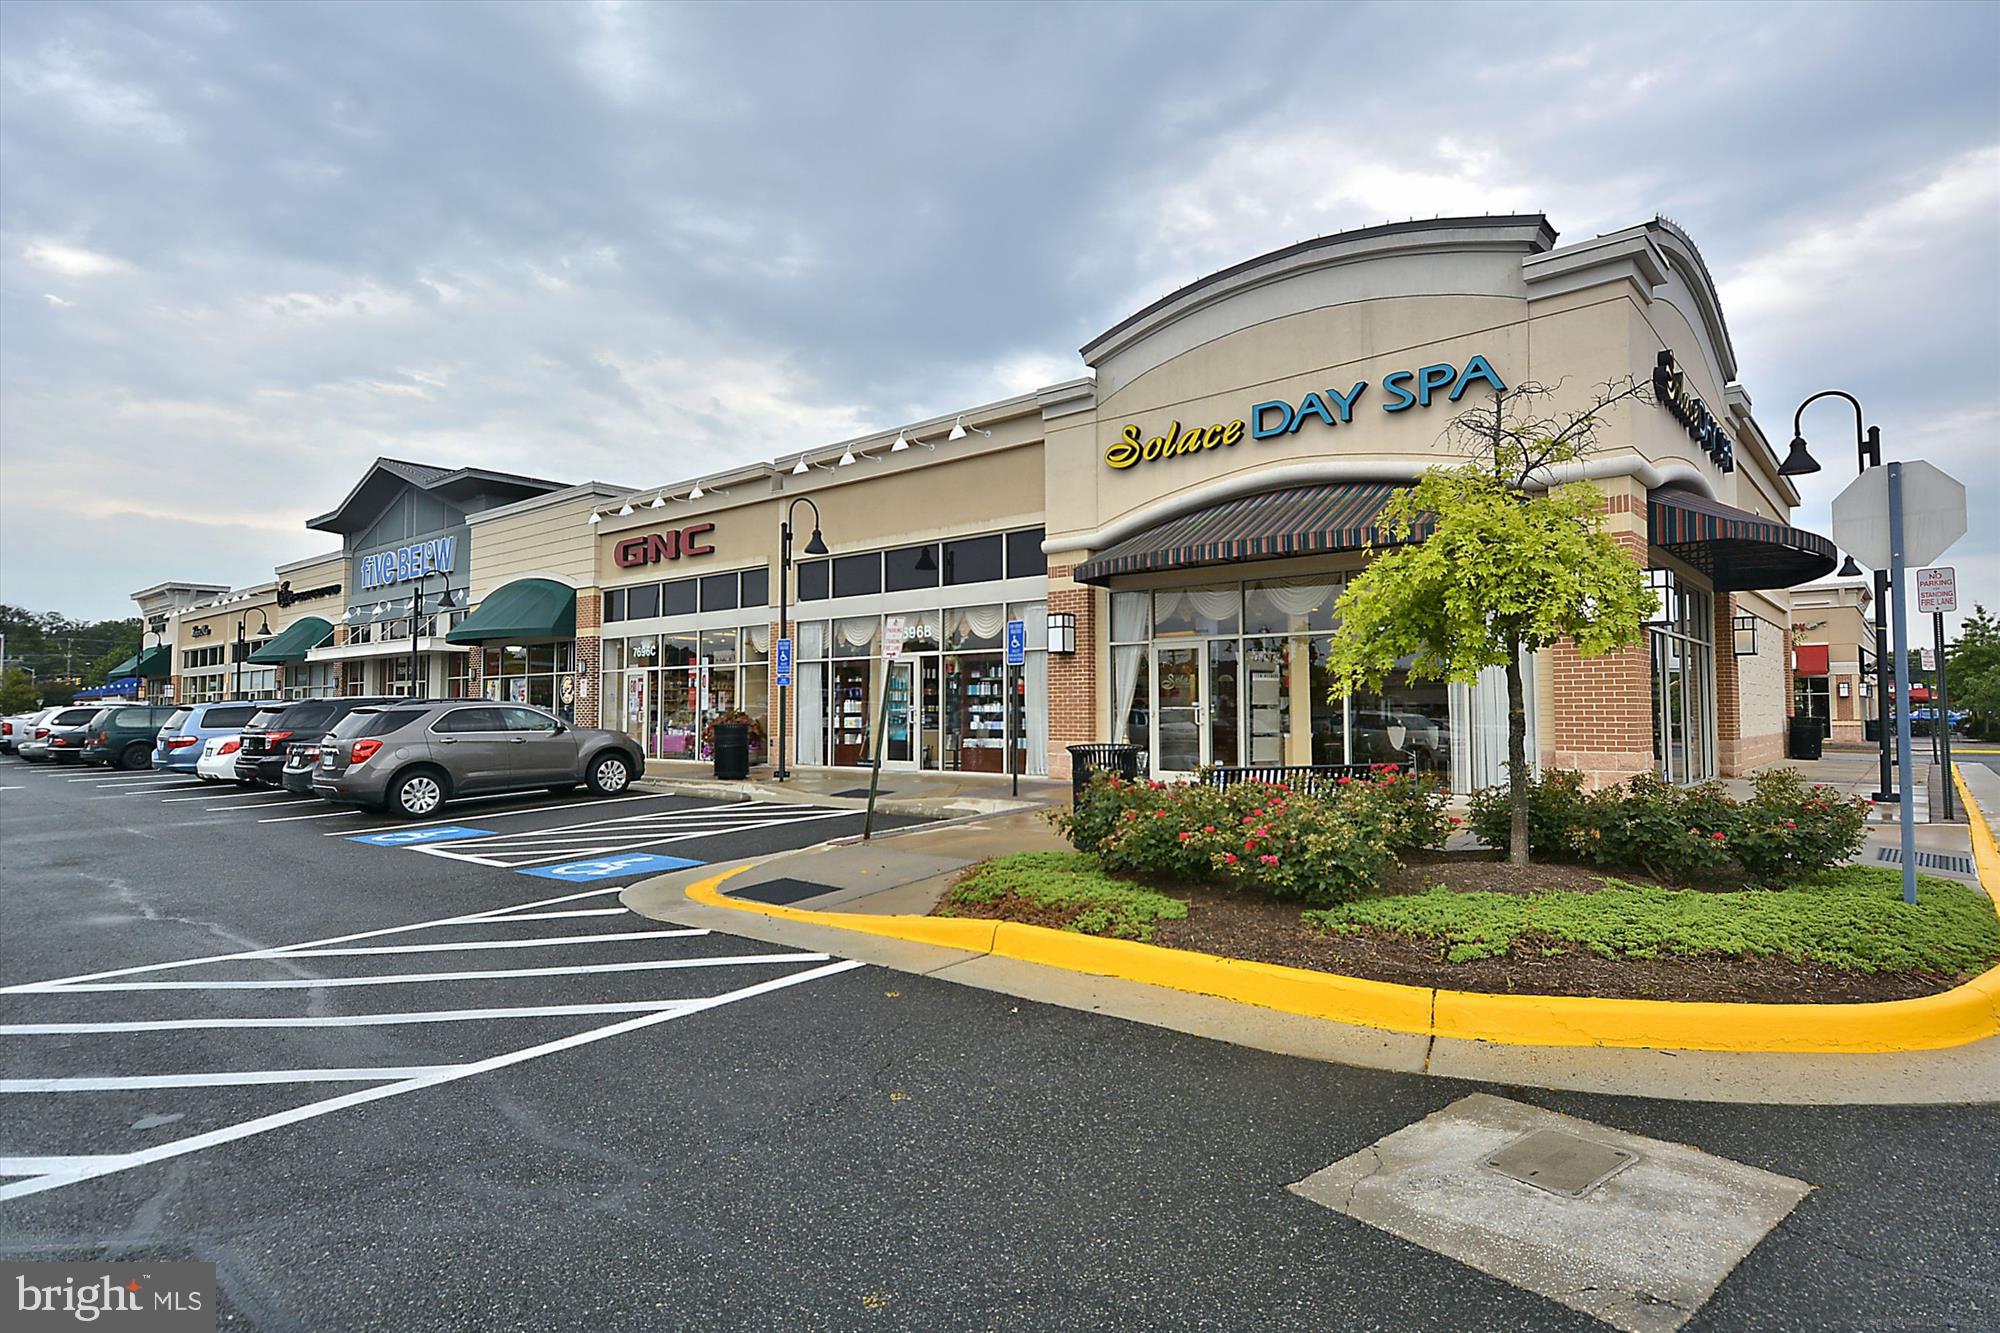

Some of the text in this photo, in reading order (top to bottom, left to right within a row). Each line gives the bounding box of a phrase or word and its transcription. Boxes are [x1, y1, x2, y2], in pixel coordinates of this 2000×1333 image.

[1105, 354, 1507, 469] Solace DAY SPA
[614, 523, 715, 568] GNC
[1920, 579, 1952, 587] PARKING
[1936, 597, 1953, 605] LANE
[903, 625, 932, 639] 696B
[633, 645, 656, 657] 7696C
